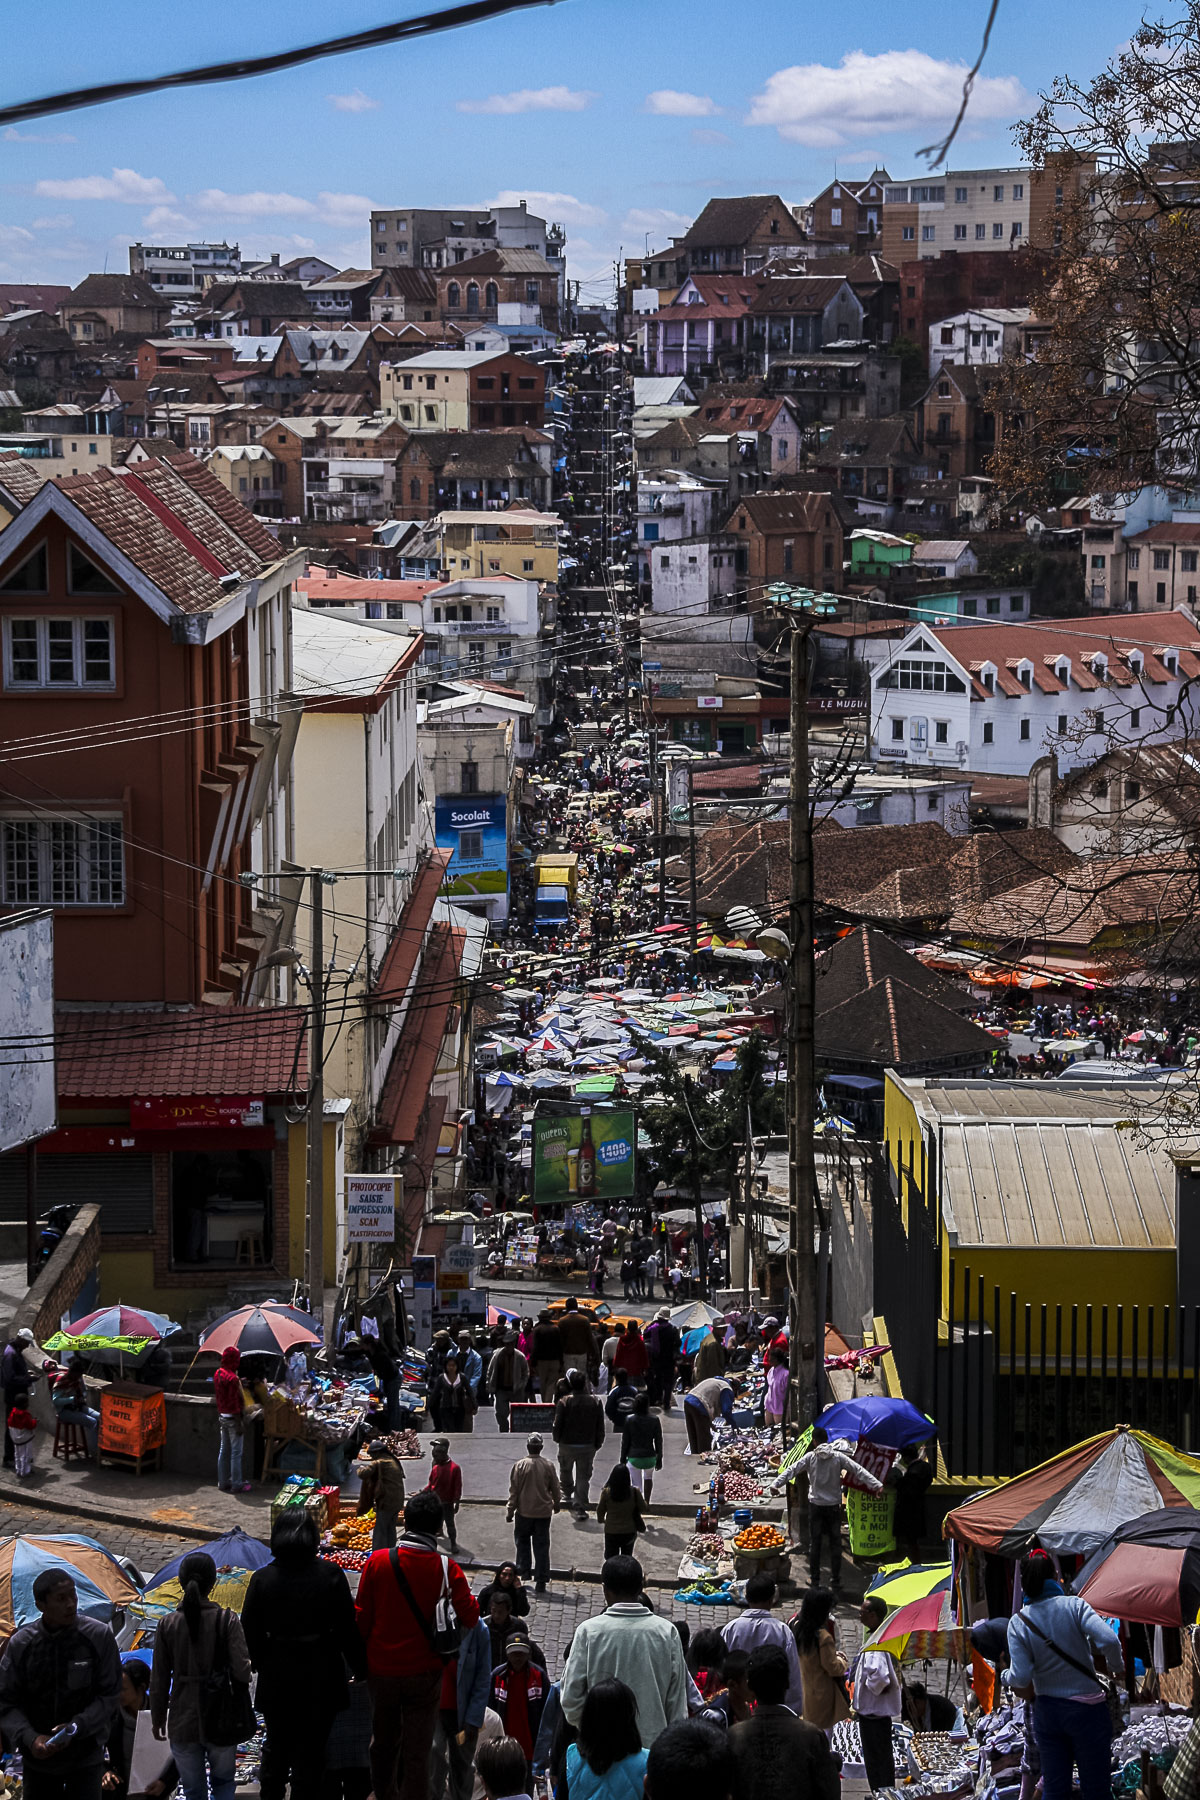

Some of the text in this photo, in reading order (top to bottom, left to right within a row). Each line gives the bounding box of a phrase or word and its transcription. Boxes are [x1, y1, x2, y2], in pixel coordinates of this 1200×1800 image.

[820, 700, 833, 708] LE
[451, 810, 491, 821] Socolait
[600, 1142, 626, 1159] 1400
[350, 1182, 393, 1191] PHOTOCOPIE
[359, 1194, 384, 1203] SAISIE
[348, 1205, 393, 1214] IMPRESSION
[359, 1217, 379, 1226] SCAN
[861, 1503, 889, 1512] SPEED
[860, 1514, 889, 1522] 2 TOI
[869, 1522, 889, 1531] MOI
